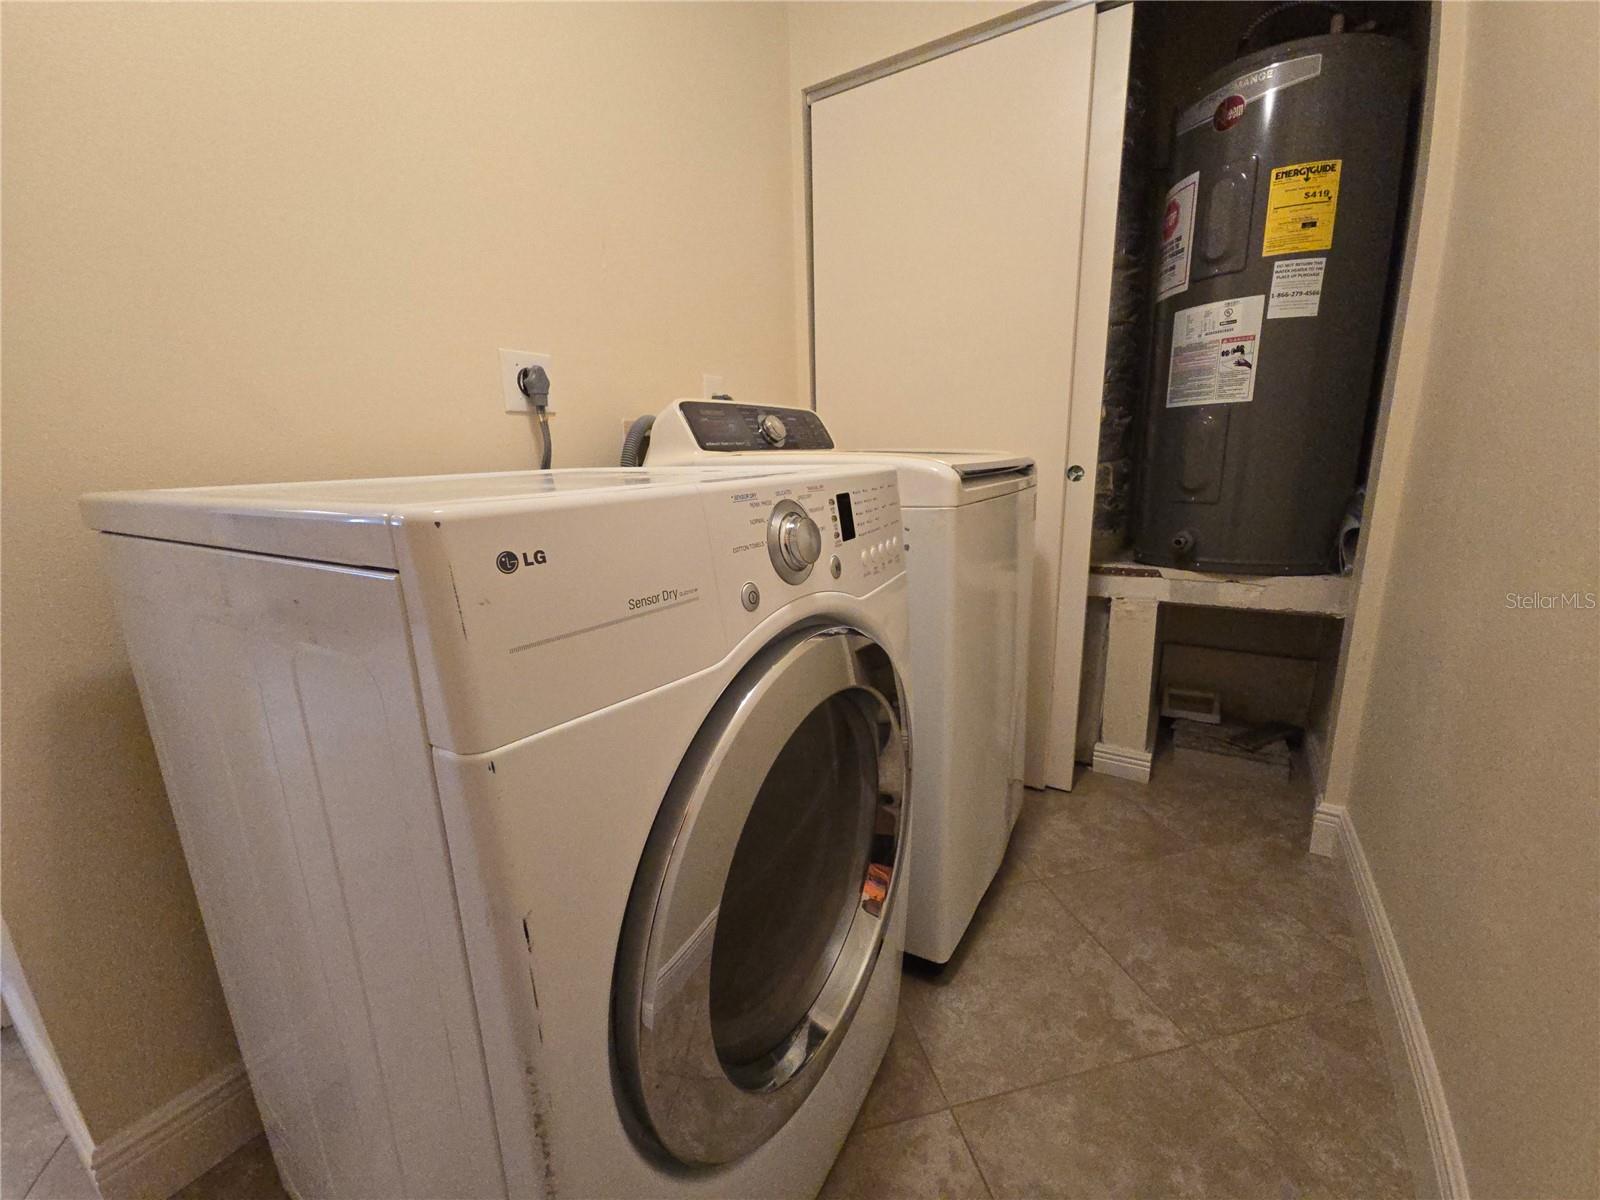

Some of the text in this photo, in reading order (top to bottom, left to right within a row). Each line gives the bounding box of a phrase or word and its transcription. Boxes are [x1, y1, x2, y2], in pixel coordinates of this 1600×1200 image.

[1275, 163, 1336, 180] ENERGYGUIDE
[523, 550, 547, 566] LG
[628, 594, 660, 610] Sensor
[662, 589, 678, 601] Dry
